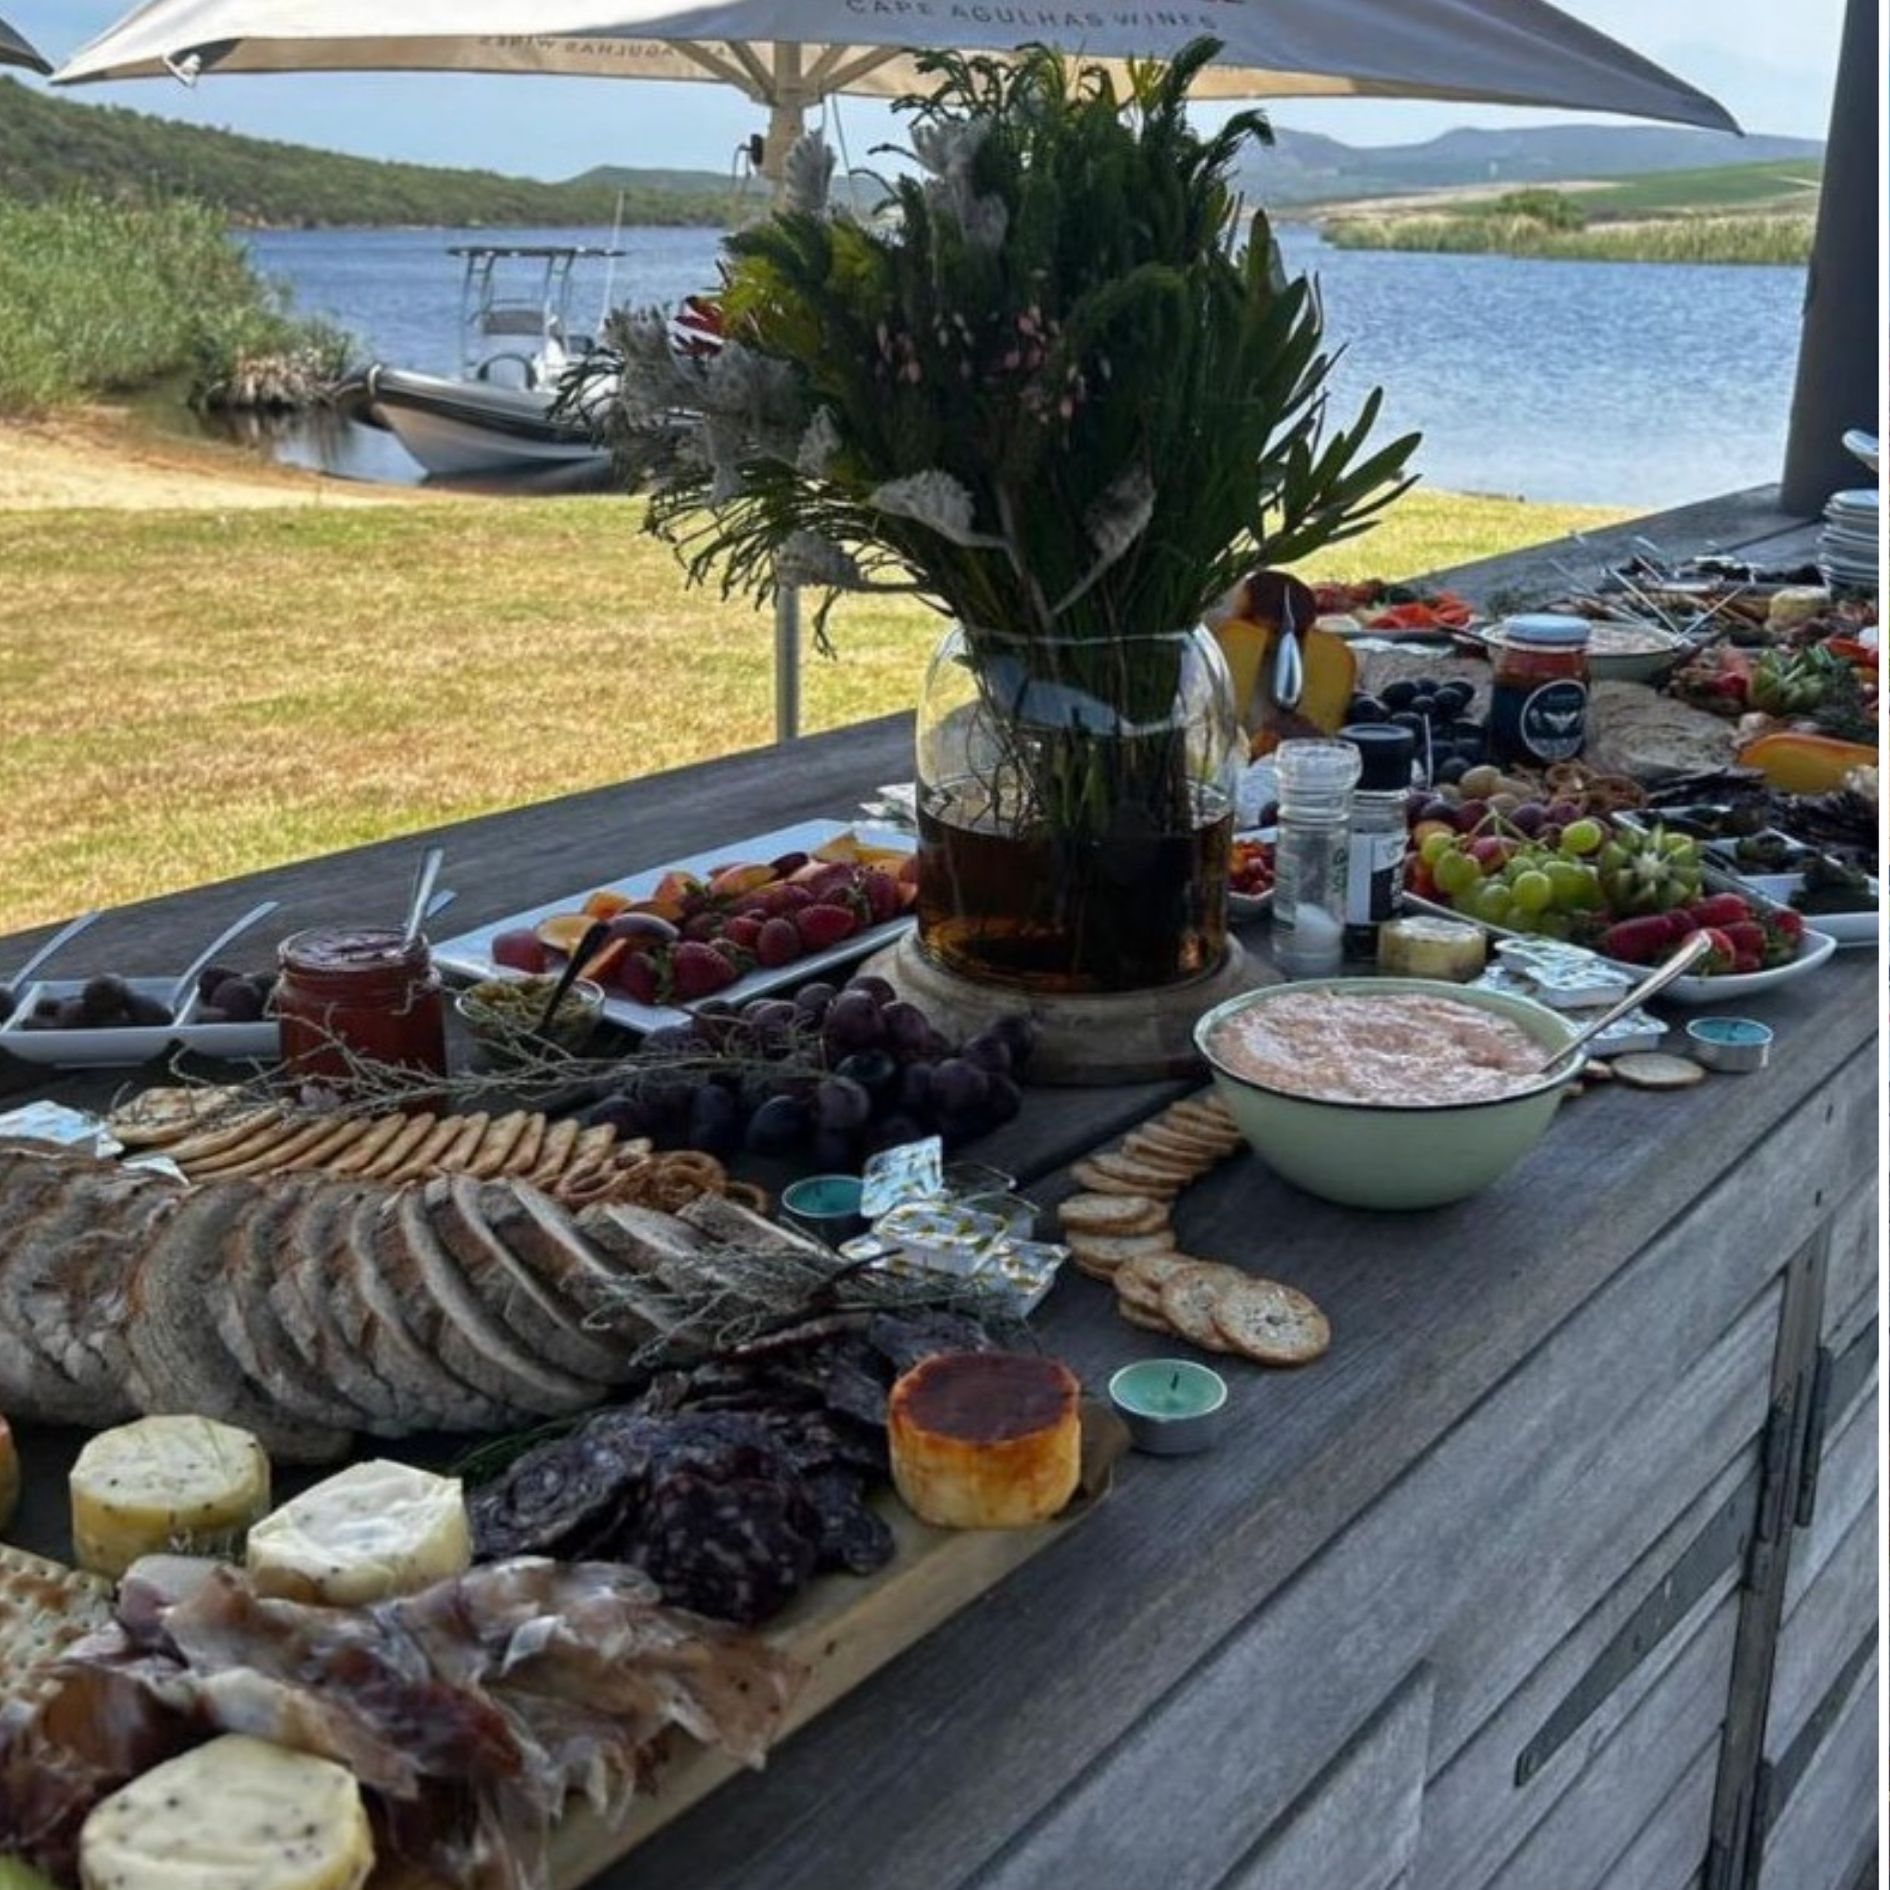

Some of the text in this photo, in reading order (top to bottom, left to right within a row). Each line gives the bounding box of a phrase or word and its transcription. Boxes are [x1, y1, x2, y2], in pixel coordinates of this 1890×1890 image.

[846, 0, 1218, 30] CAPE AGULHAS WINES
